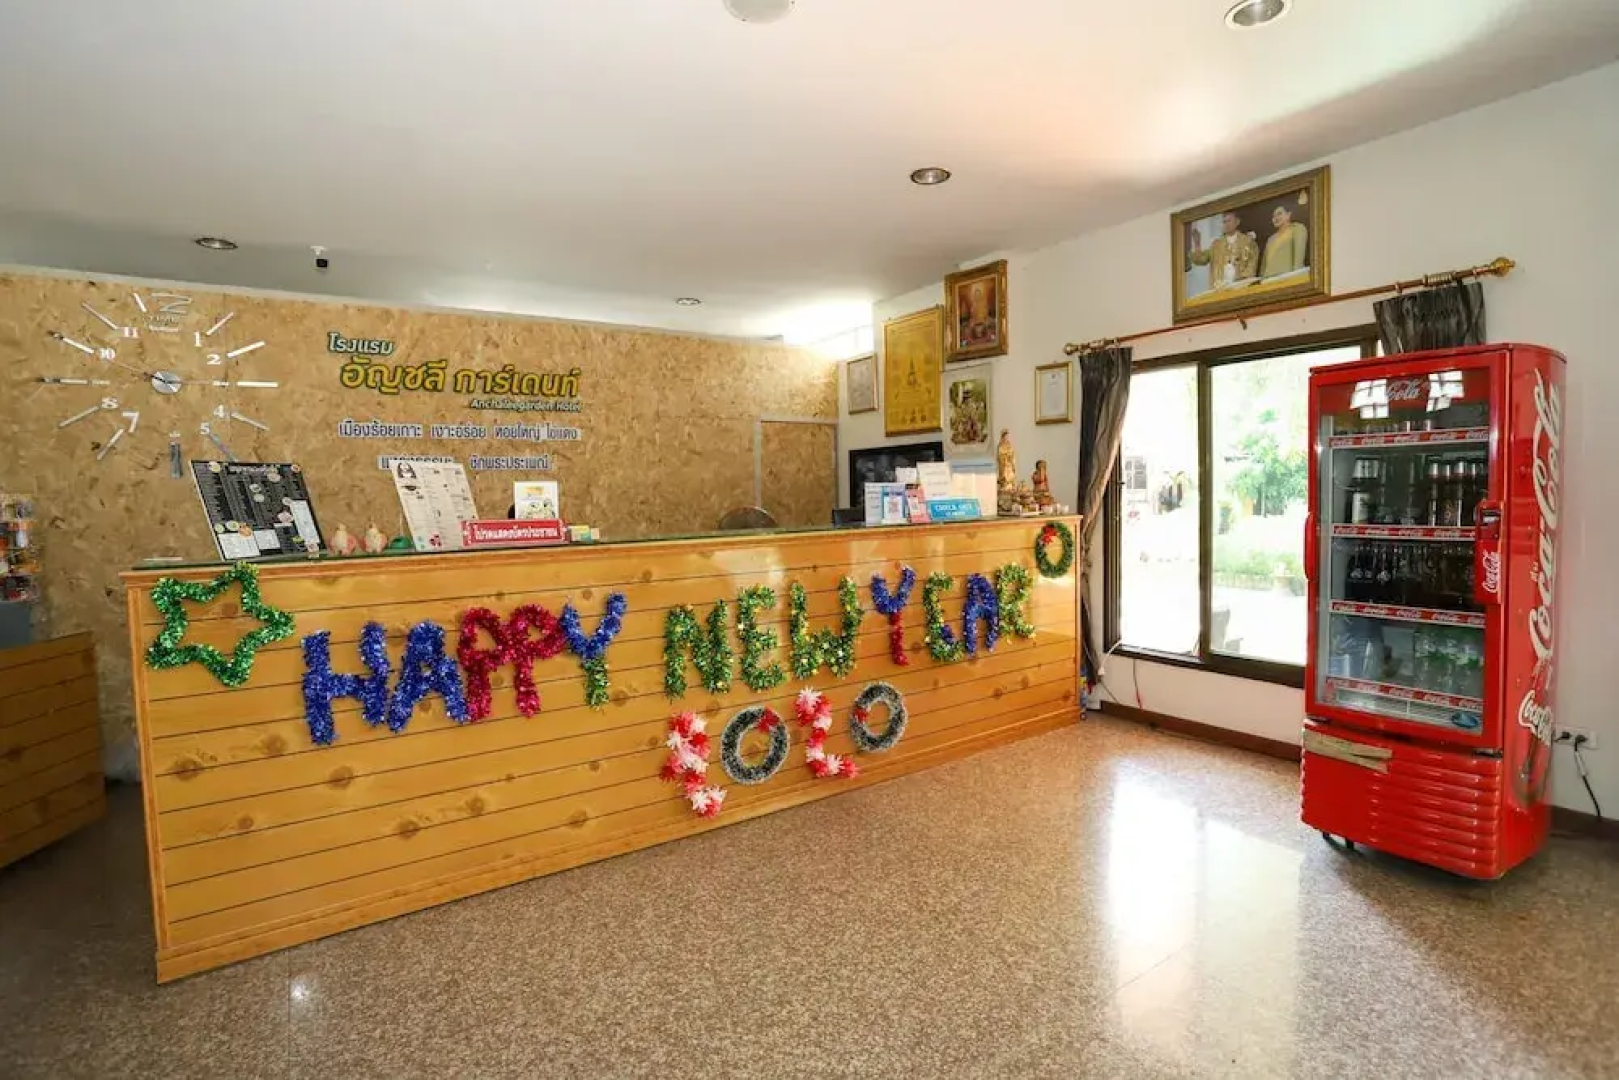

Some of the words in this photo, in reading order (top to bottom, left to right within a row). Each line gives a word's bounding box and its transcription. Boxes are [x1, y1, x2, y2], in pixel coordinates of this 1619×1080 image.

[207, 353, 222, 365] 2
[327, 332, 394, 355] โรงแรม
[340, 357, 448, 395] อัญชลี
[453, 364, 582, 398] การ์เดนท์
[122, 411, 140, 433] 7
[1528, 368, 1562, 660] Coca-Cola
[302, 592, 627, 746] HAPPY
[663, 576, 865, 703] NEW
[659, 681, 908, 818] 2020
